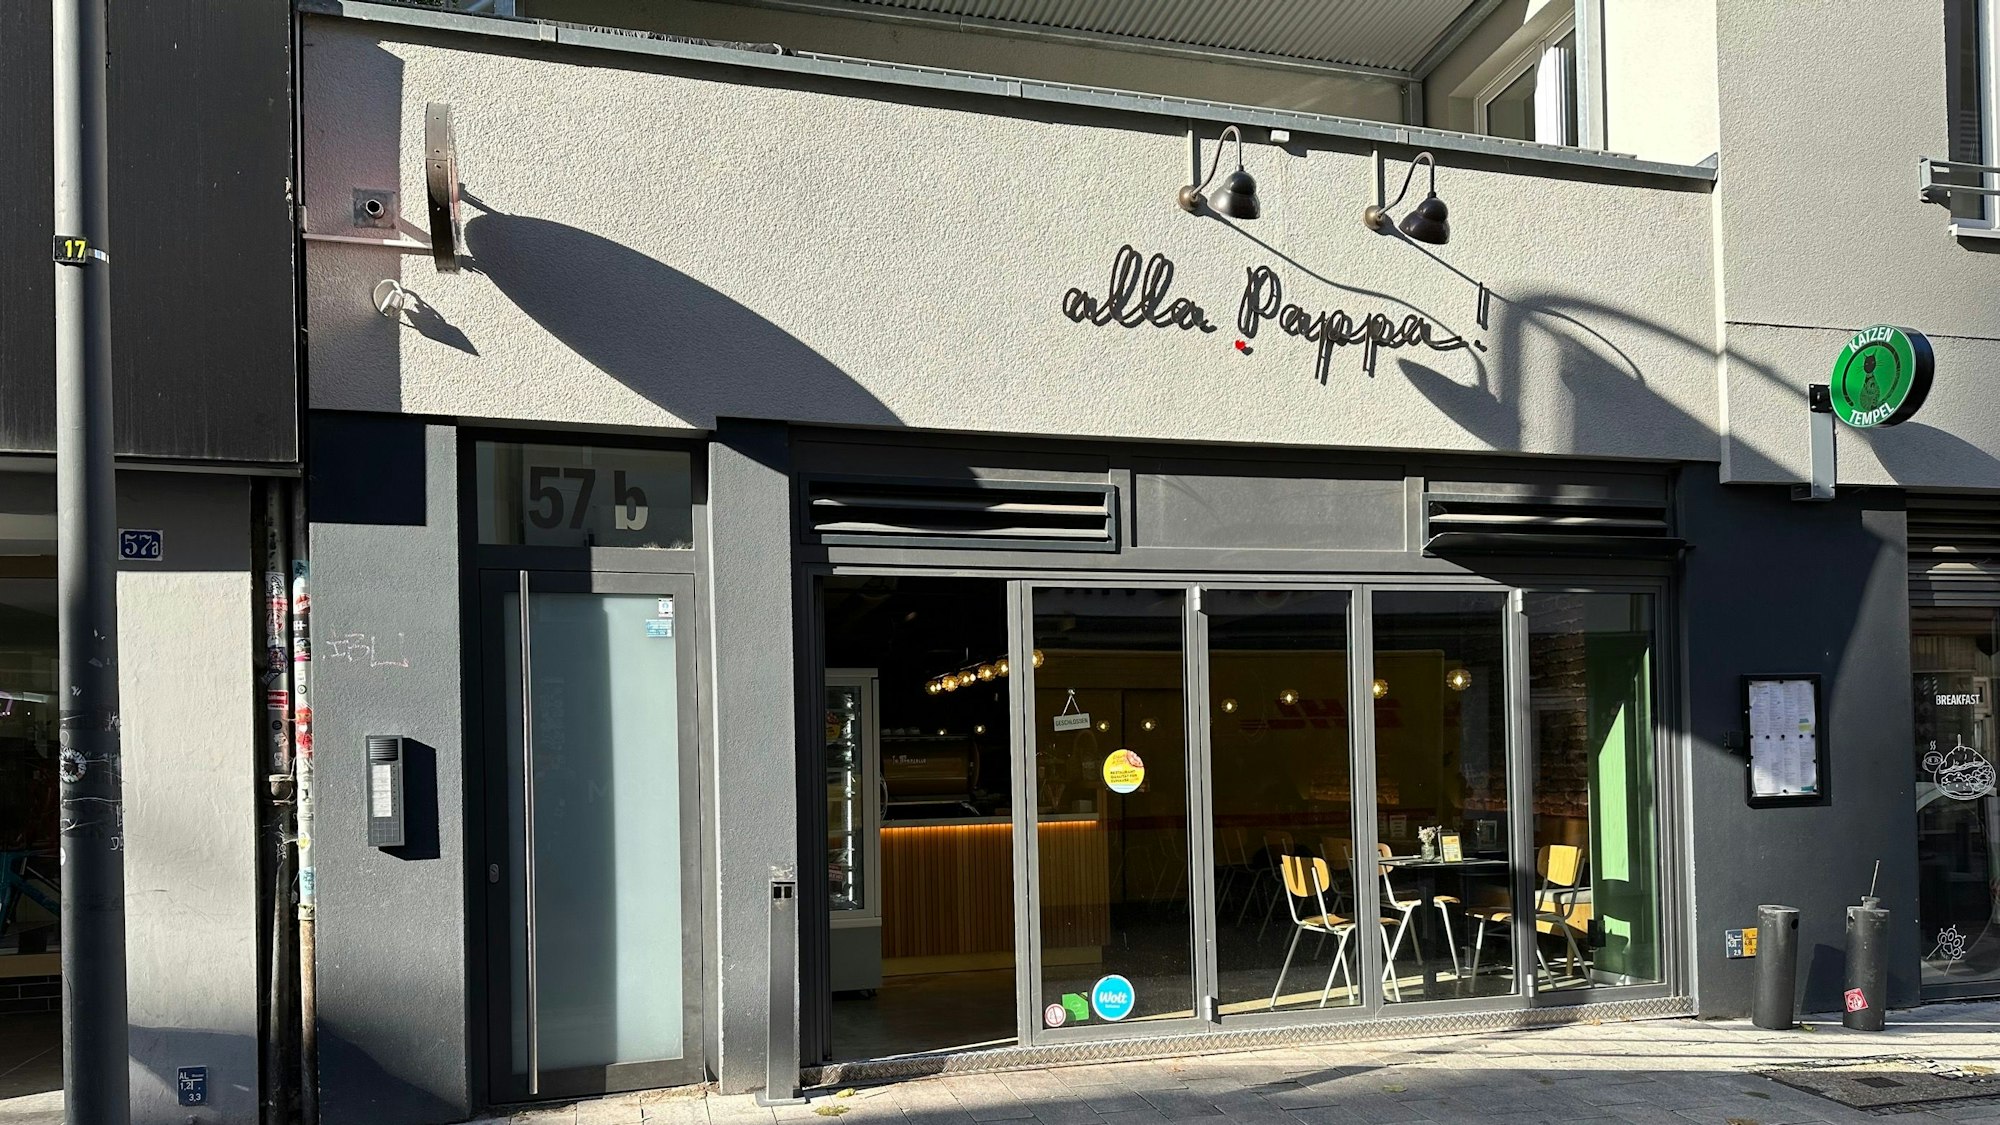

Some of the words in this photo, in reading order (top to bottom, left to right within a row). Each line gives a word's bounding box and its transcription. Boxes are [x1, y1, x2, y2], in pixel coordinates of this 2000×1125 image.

[64, 239, 86, 258] 17
[1062, 244, 1217, 332] alla
[1848, 326, 1895, 354] KATZEN
[1848, 402, 1895, 426] TEMPEL
[528, 466, 596, 530] 57
[614, 470, 649, 531] b
[124, 533, 159, 556] 57a
[1935, 694, 1980, 706] BREAKFAST
[1055, 717, 1089, 728] GESCHLOSSEN
[1099, 991, 1128, 1005] Wolt
[179, 1071, 190, 1080] AL
[188, 1093, 202, 1102] 3,3
